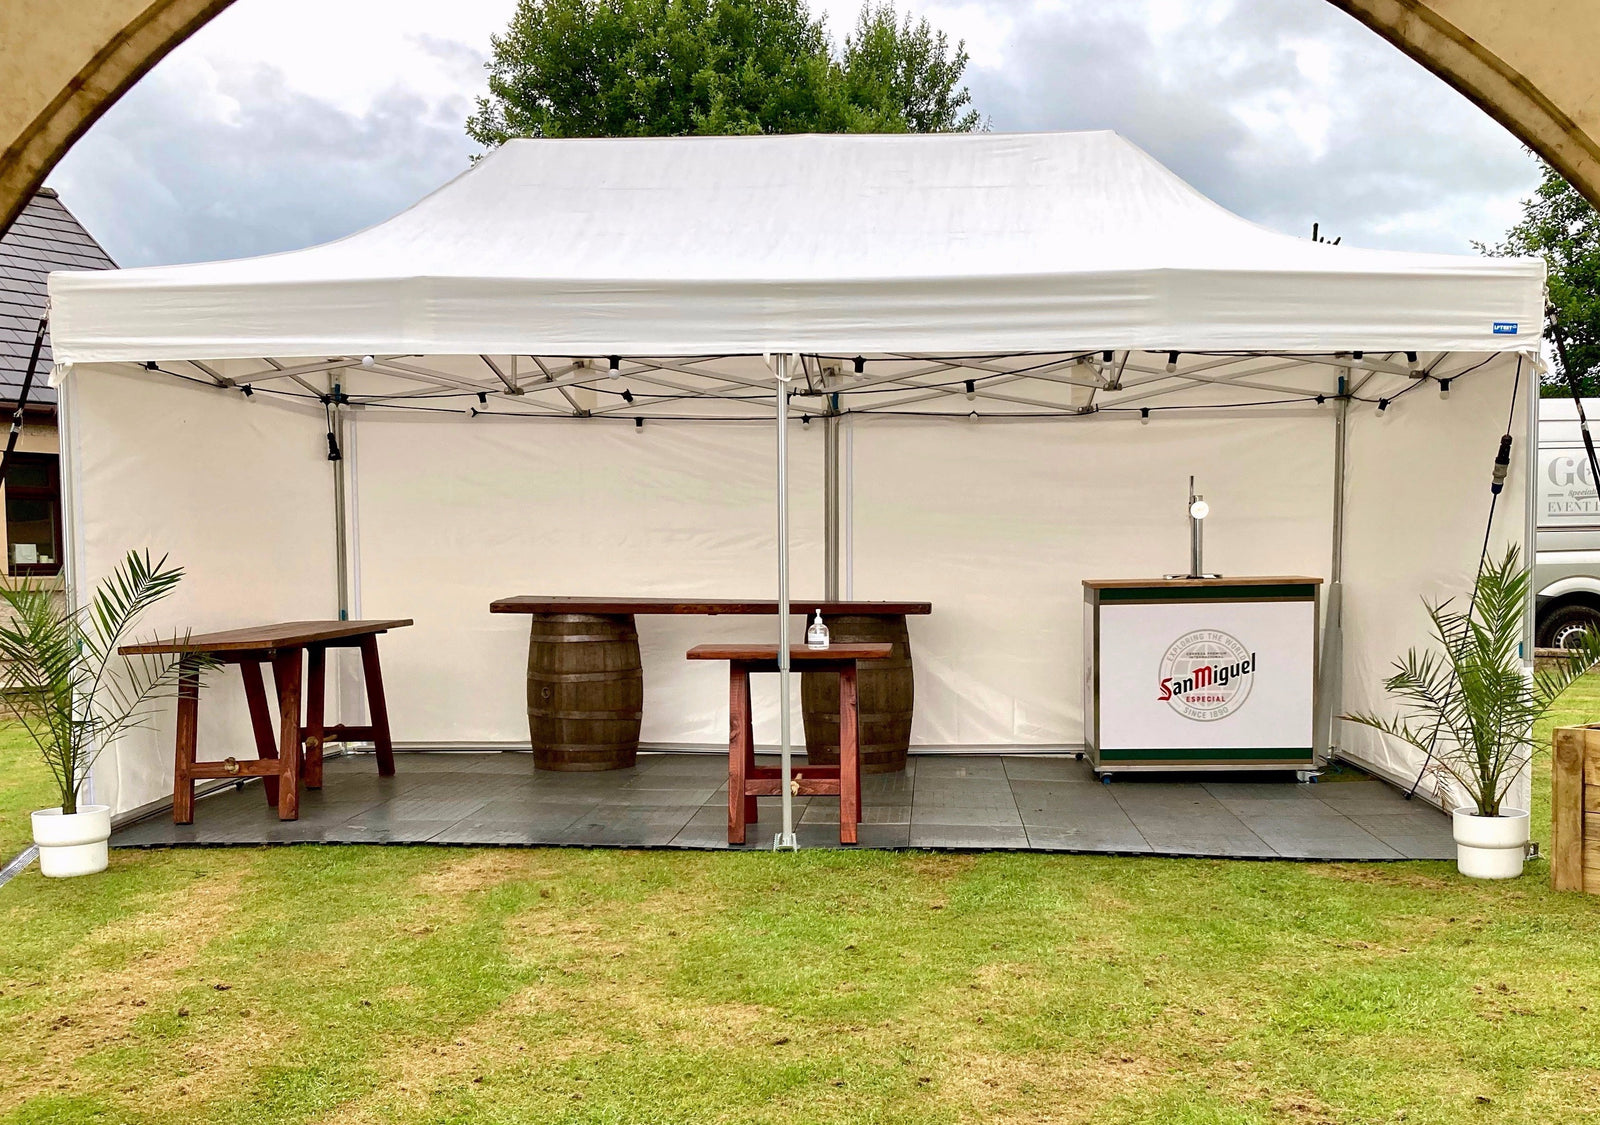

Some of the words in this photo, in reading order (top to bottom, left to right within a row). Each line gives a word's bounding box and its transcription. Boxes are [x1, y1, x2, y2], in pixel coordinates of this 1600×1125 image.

[1548, 501, 1591, 512] EVENT
[1166, 633, 1204, 662] EXPLORING
[1207, 632, 1224, 640] THE
[1225, 637, 1248, 661] WORLD
[1186, 695, 1226, 703] ESPECIAL
[1183, 706, 1207, 719] SINCE
[1209, 706, 1229, 719] 1890
